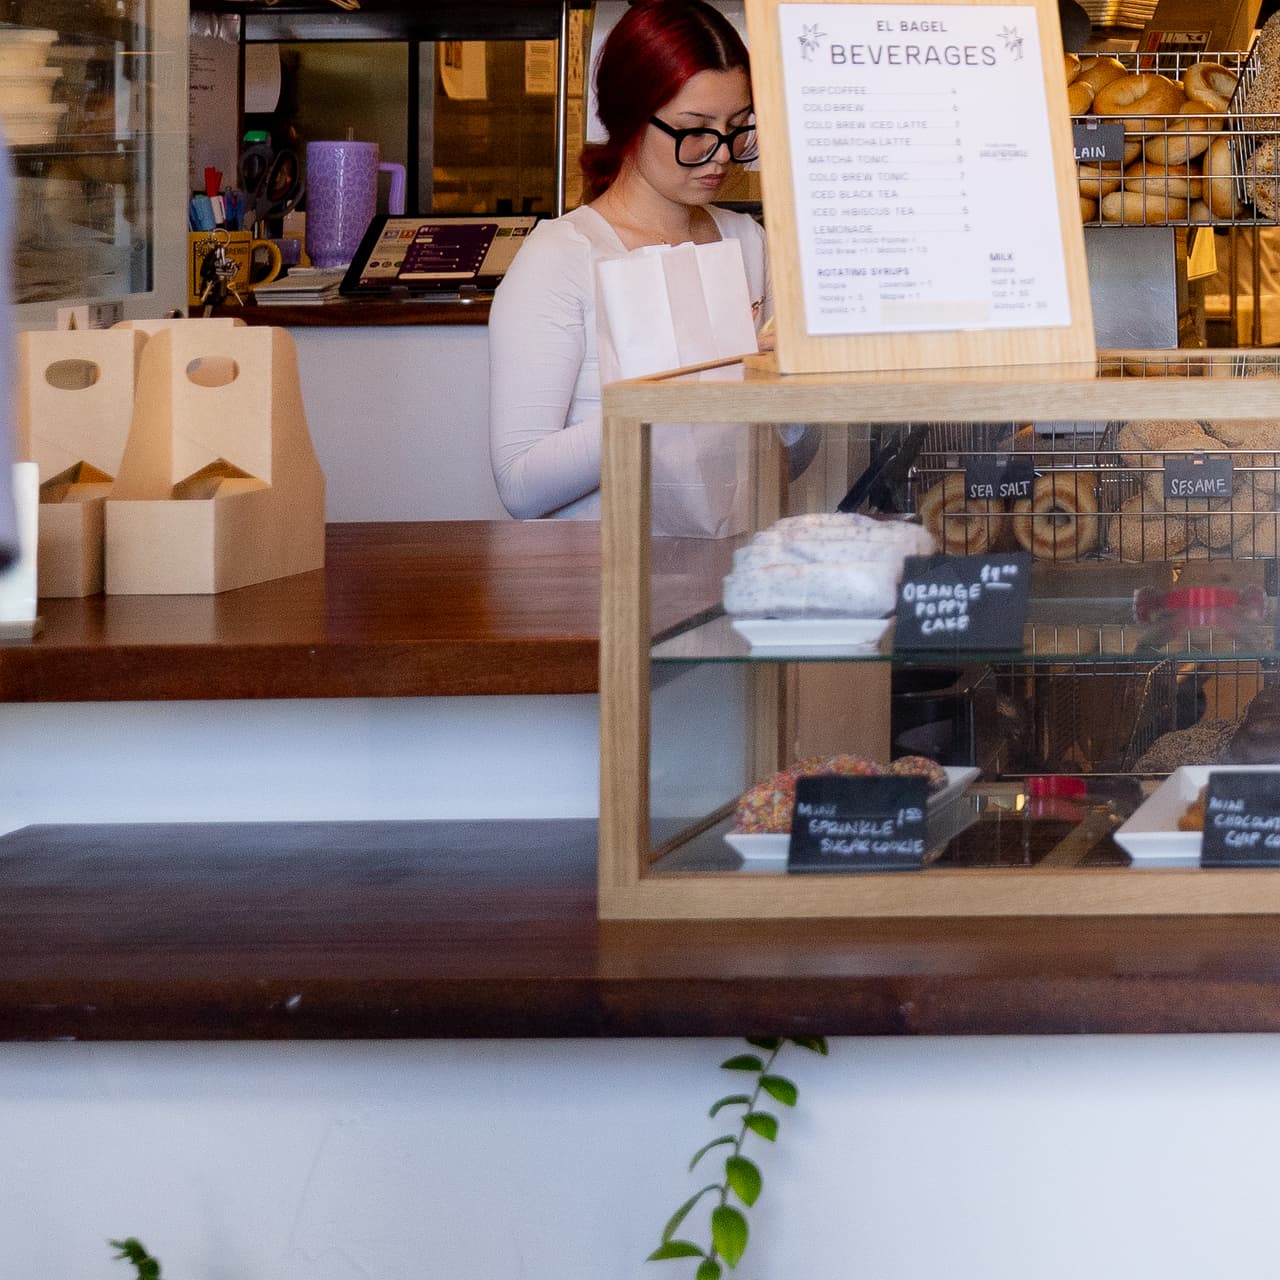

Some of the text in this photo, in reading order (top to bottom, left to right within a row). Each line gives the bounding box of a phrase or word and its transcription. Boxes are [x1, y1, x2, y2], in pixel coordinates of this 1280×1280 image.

[876, 20, 948, 33] EL BAGEL
[830, 44, 997, 66] BEVERAGES
[970, 480, 1031, 498] SEA SALT
[1171, 477, 1228, 496] SESAME
[903, 582, 981, 602] ORANGE
[915, 599, 968, 617] POPPY
[921, 614, 970, 634] CAKE
